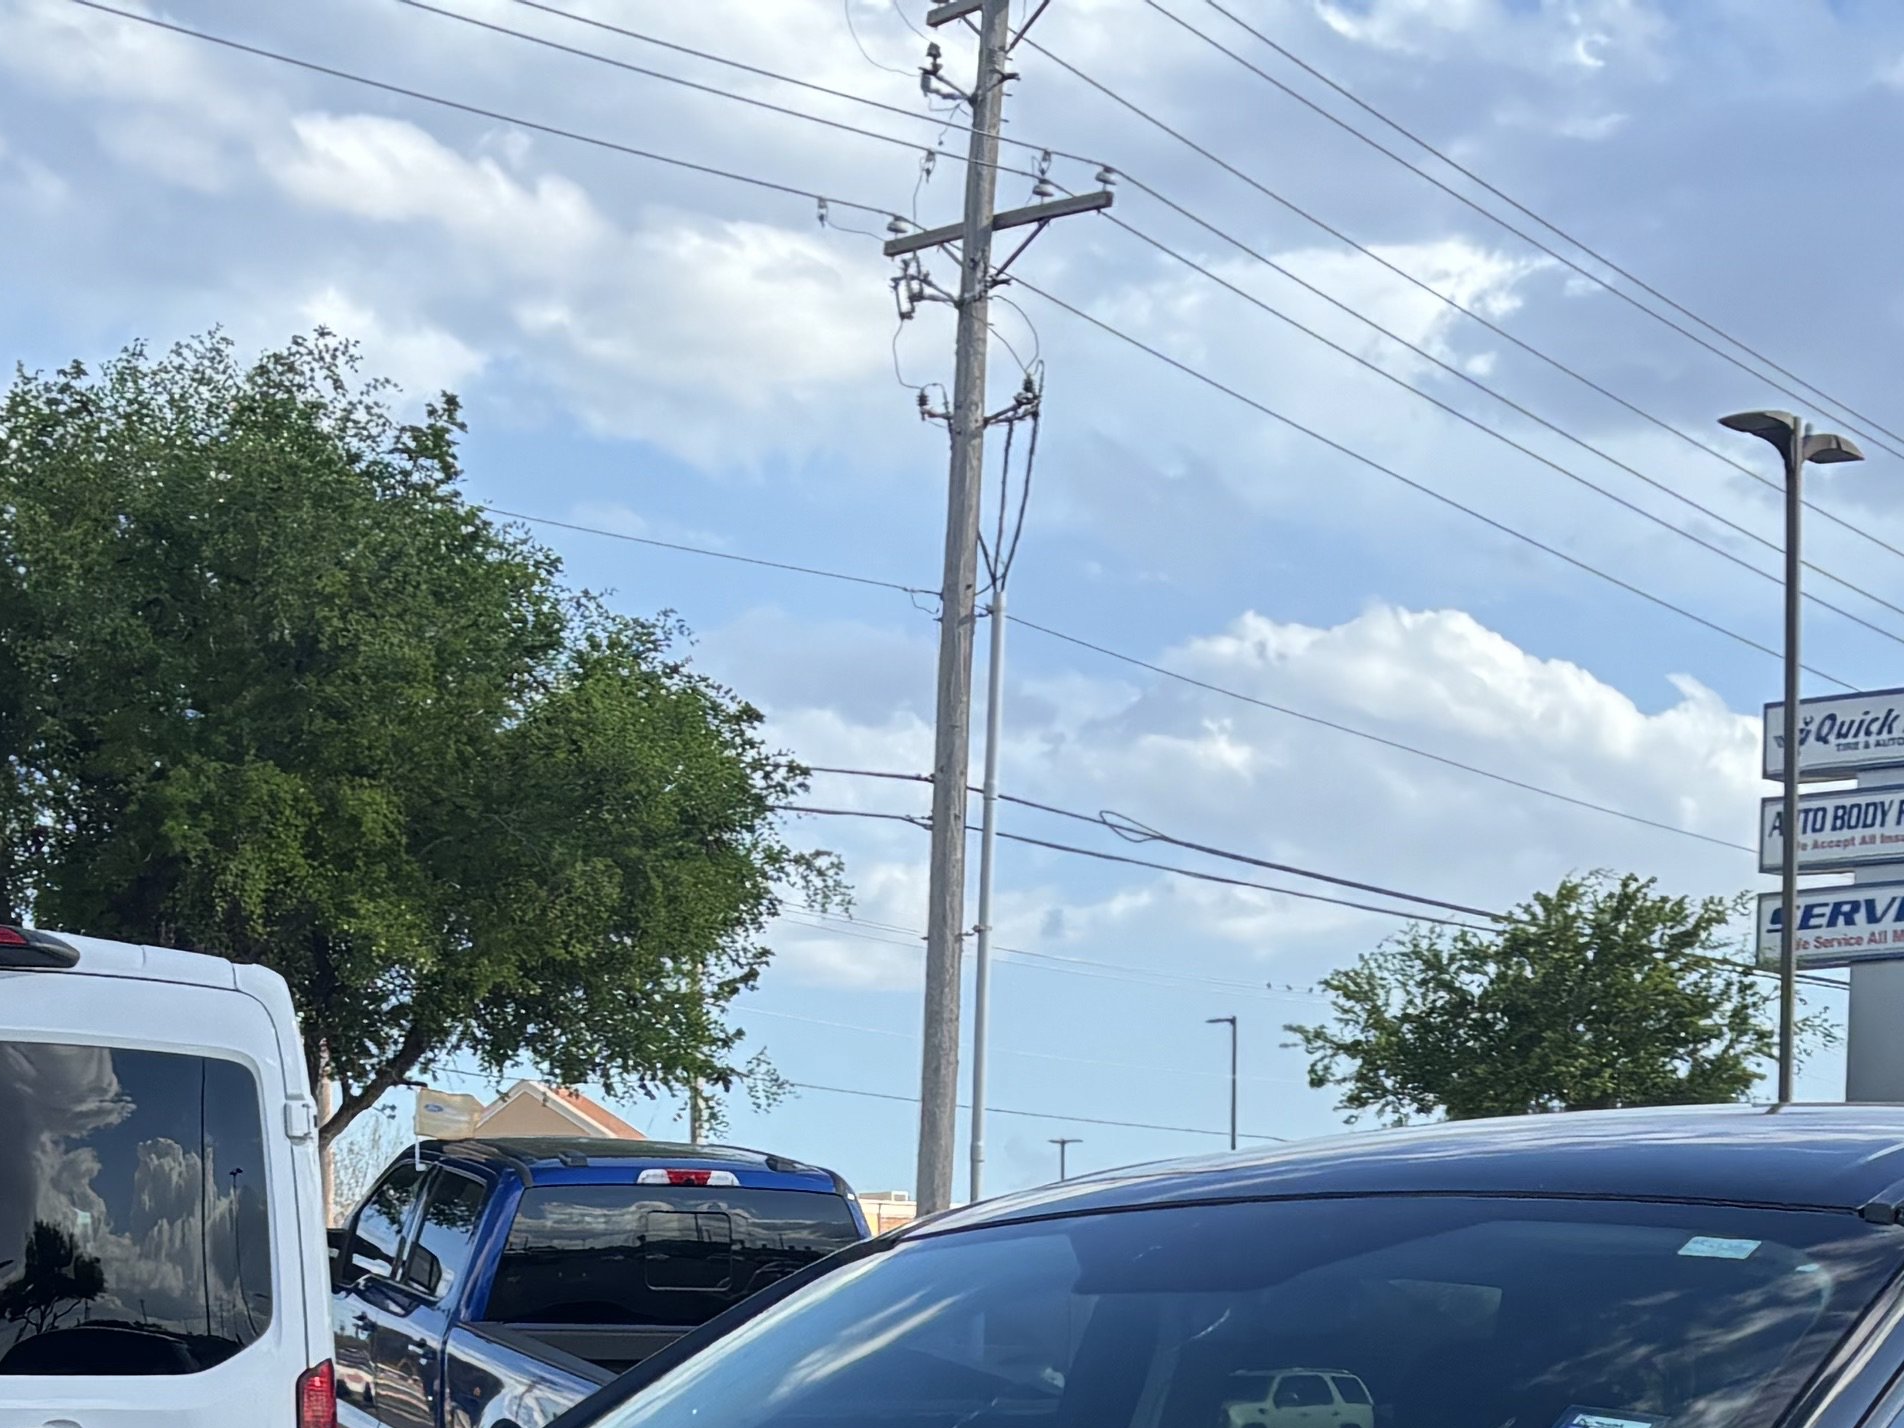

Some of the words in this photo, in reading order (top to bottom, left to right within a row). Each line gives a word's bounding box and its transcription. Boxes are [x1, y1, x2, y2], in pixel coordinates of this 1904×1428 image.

[1815, 708, 1900, 744] Quick
[1836, 741, 1860, 751] TIRE
[1863, 739, 1871, 750] &
[1768, 807, 1827, 838] ATO
[1831, 800, 1894, 832] BODY
[1812, 836, 1855, 850] Accept
[1859, 834, 1876, 845] All
[1813, 934, 1864, 949] Service
[1867, 930, 1888, 945] All
